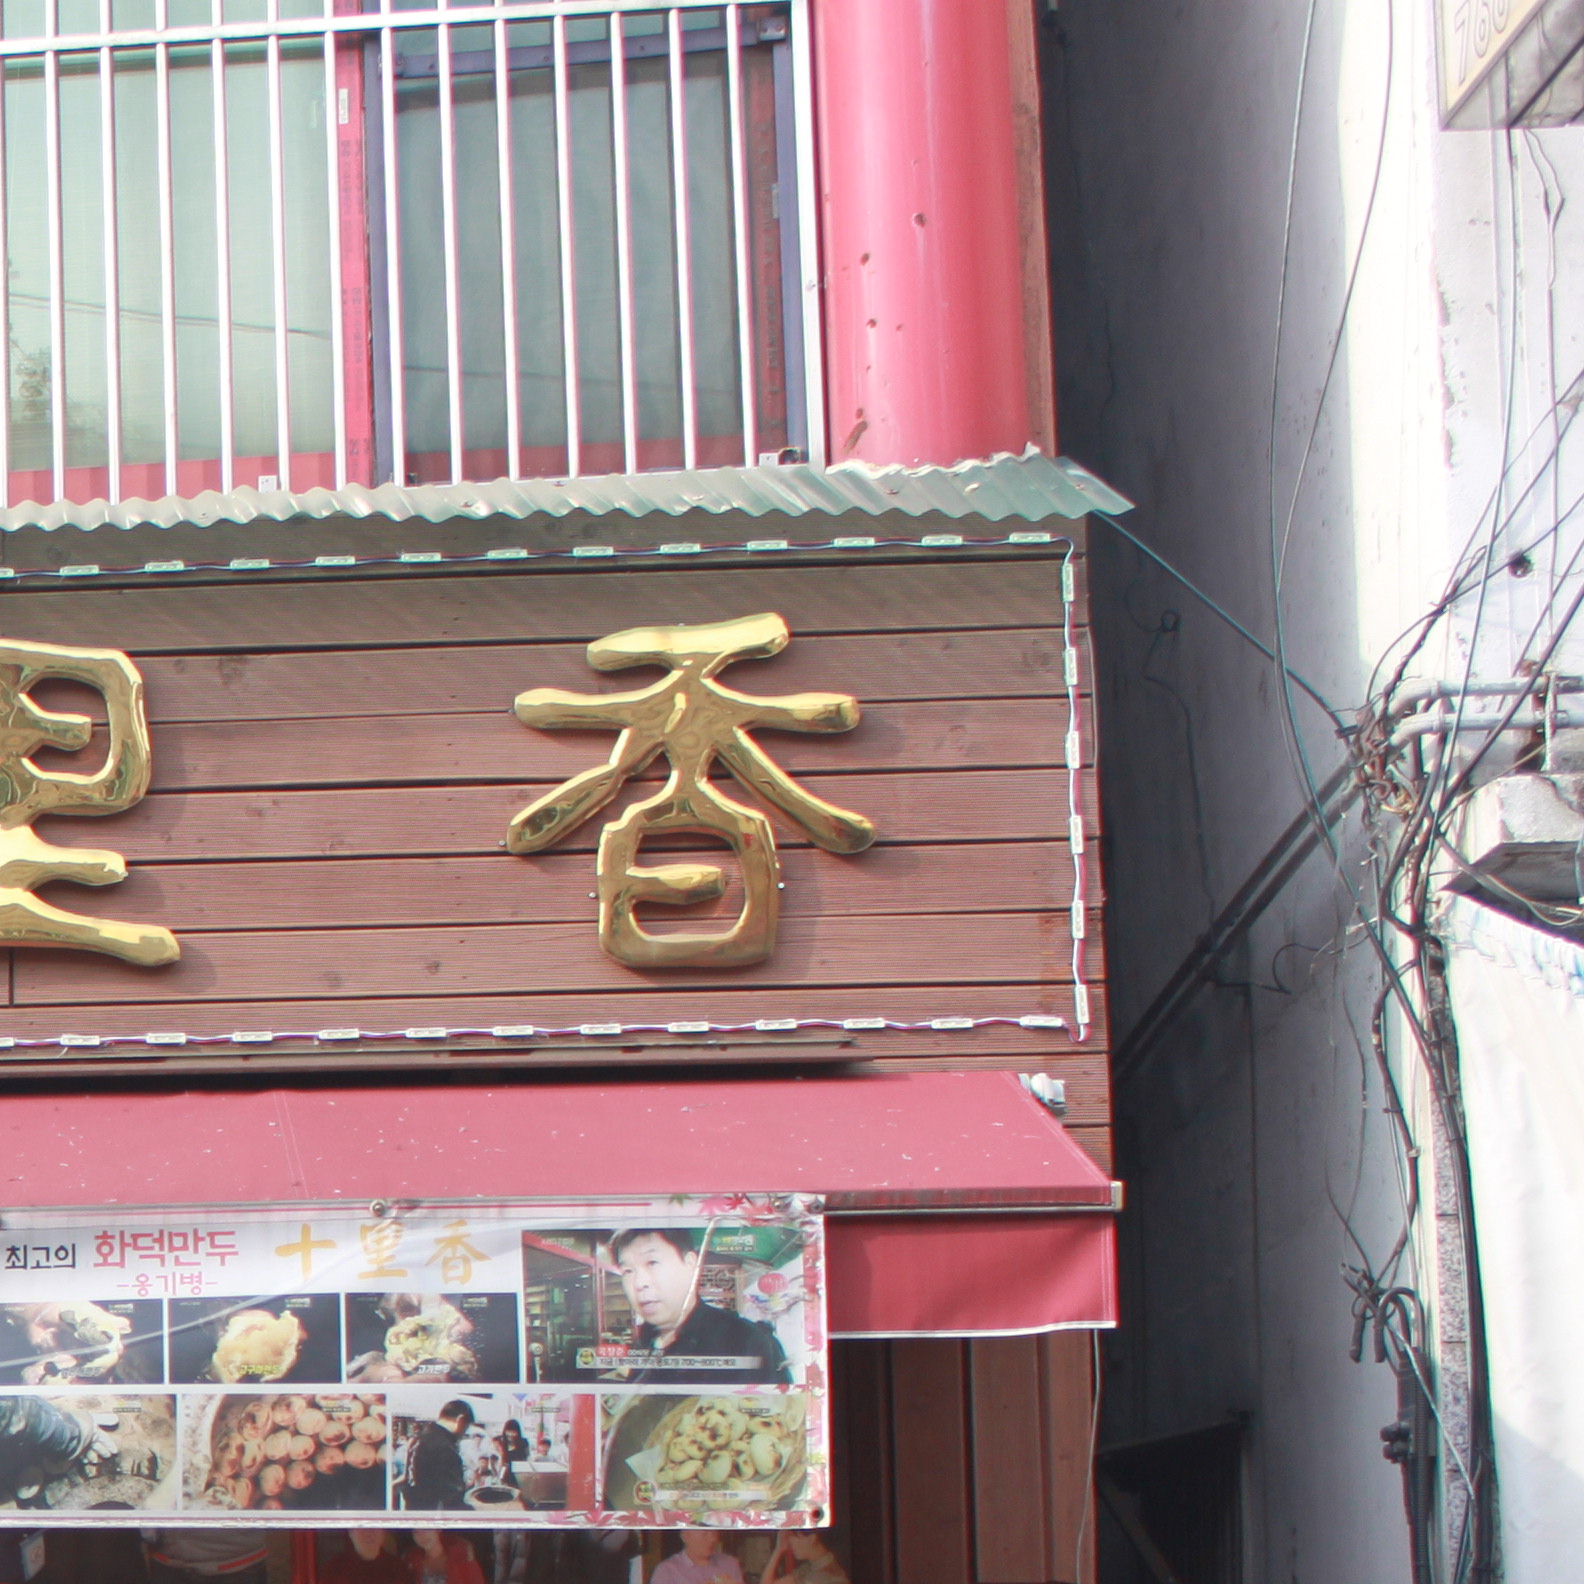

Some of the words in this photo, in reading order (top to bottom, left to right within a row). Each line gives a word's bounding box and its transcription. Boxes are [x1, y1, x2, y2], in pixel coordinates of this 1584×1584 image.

[4, 1243, 77, 1272] 최고의
[93, 1227, 239, 1272] 화덕만두
[274, 1218, 493, 1286] 十里香
